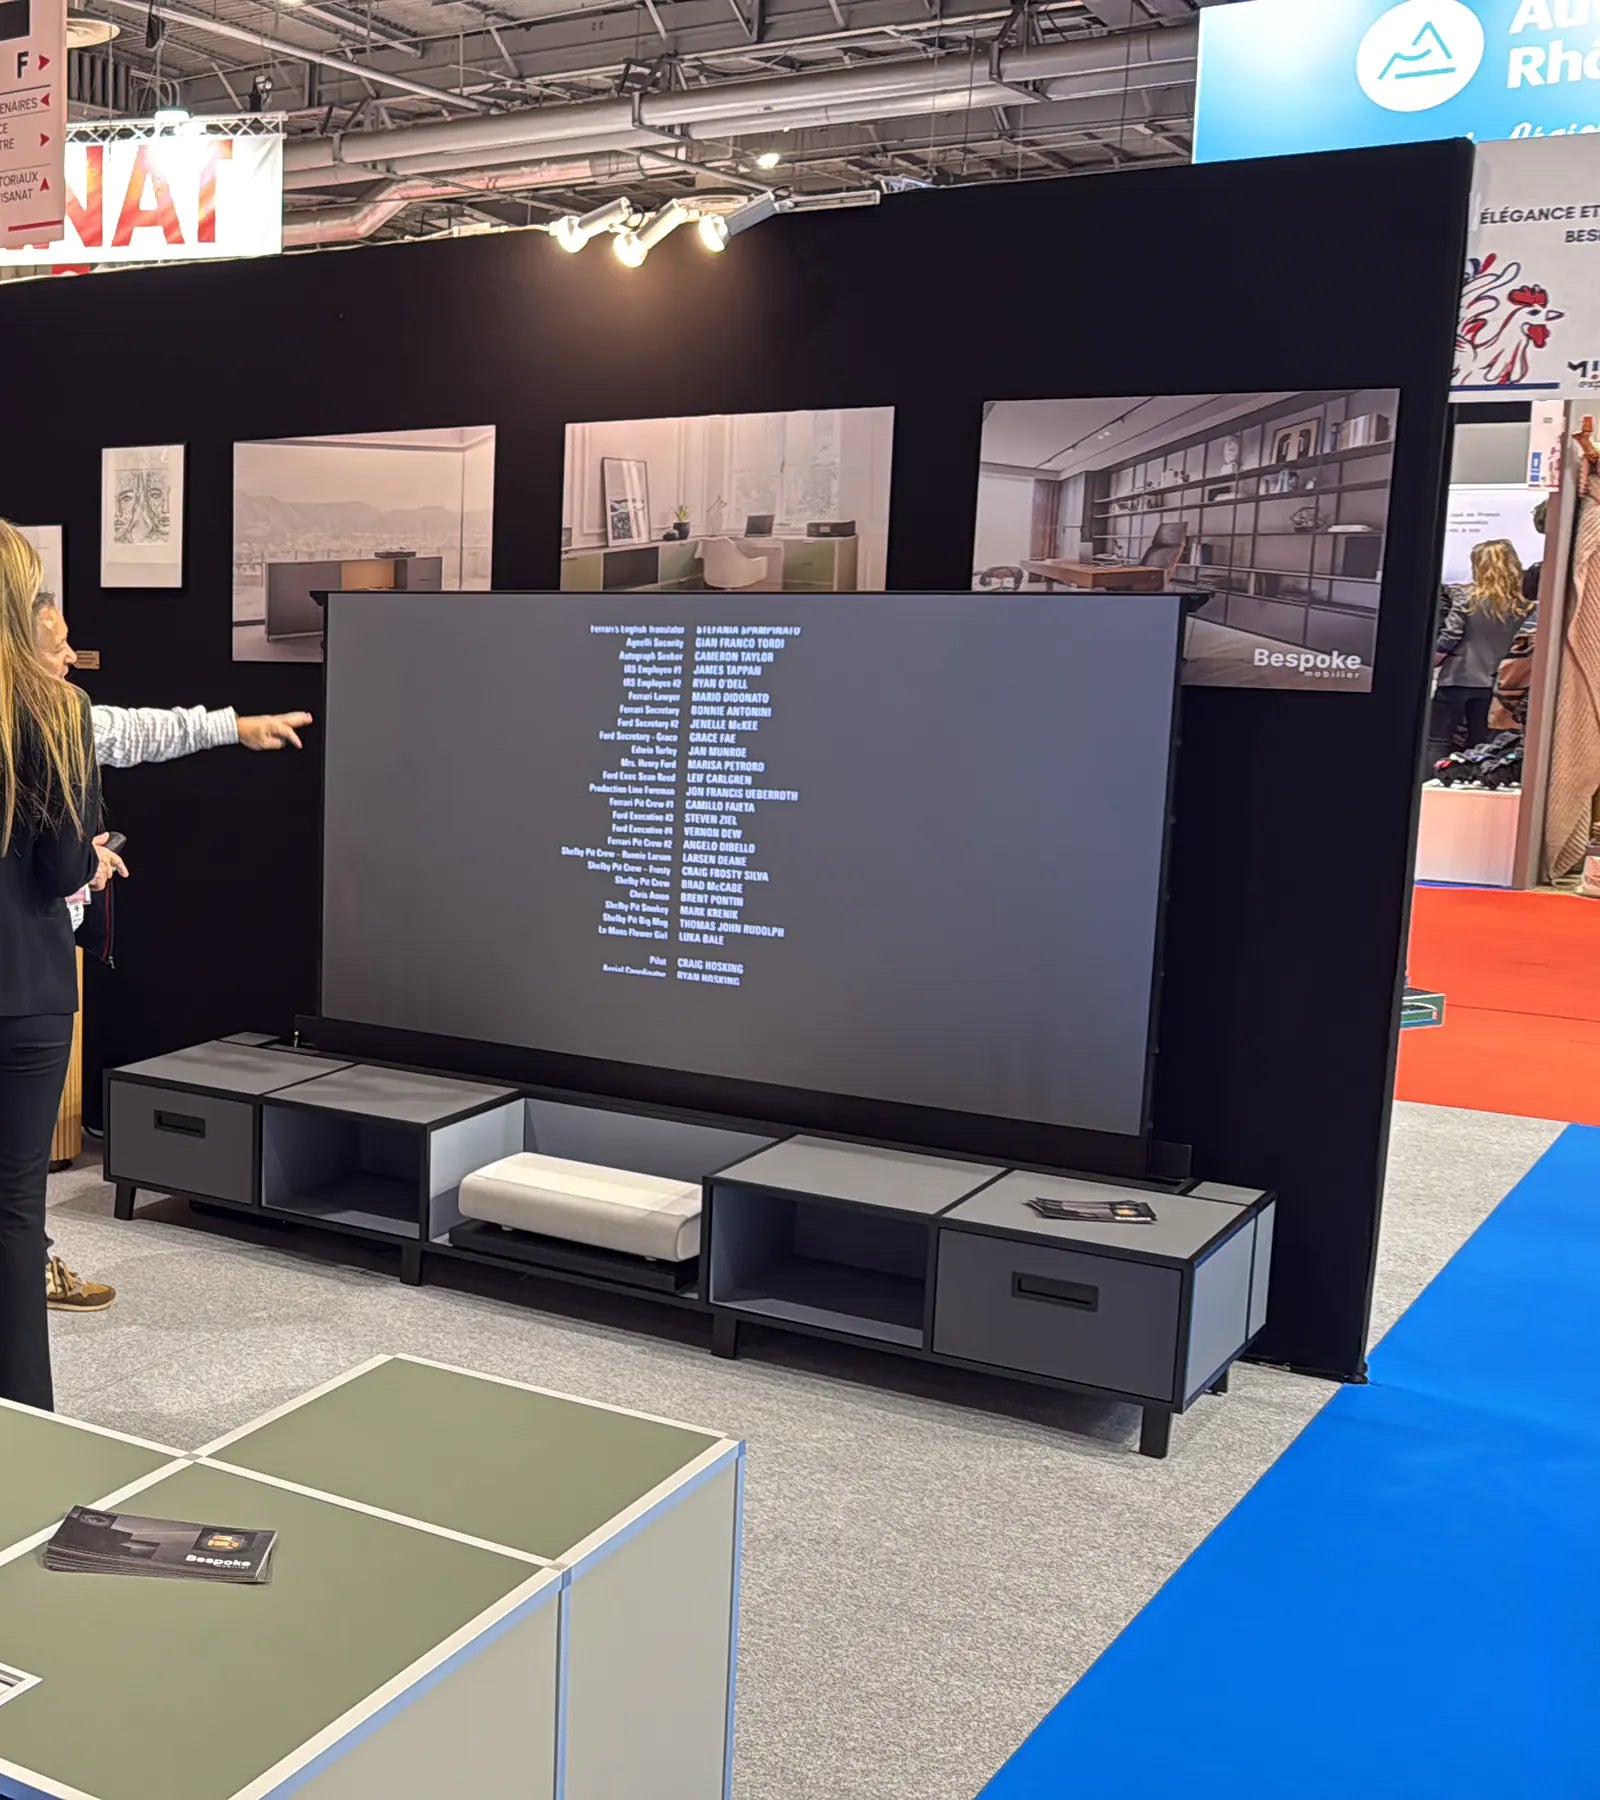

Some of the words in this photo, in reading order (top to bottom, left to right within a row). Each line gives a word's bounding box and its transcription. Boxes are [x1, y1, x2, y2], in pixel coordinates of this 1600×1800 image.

[1508, 0, 1600, 34] Au
[17, 51, 29, 78] F
[1480, 206, 1576, 224] ÉLÉGANCE
[1565, 229, 1600, 242] BES
[696, 638, 717, 648] GIAN
[720, 638, 755, 648] FRANCO
[695, 652, 738, 661] CAMERON
[741, 652, 774, 662] TAYLOR
[1254, 648, 1361, 672] Bespoke
[693, 665, 724, 675] JAMES
[726, 665, 762, 675] TAPPAN
[693, 679, 716, 688] RYAN
[718, 679, 748, 689] O'DELL
[692, 692, 721, 702] MARIO
[723, 693, 769, 703] DIDONATO
[645, 706, 680, 716] Secretary
[690, 706, 725, 716] BONNIE
[727, 707, 772, 717] ANTONINI
[618, 718, 633, 727] Ford
[635, 718, 668, 729] Secretary
[690, 719, 726, 729] JENELLE
[728, 720, 758, 730] McKEE
[599, 731, 615, 740] Ford
[617, 732, 650, 742] Secretary
[690, 733, 718, 743] GRACE
[720, 733, 736, 743] FAE
[688, 746, 706, 756] JAN
[709, 747, 747, 757] MUNROE
[660, 760, 676, 768] Ford
[688, 760, 722, 770] MARISA
[603, 771, 618, 780] Ford
[687, 773, 704, 783] LEIF
[706, 774, 752, 785] CARLGREN
[686, 787, 704, 796] JON
[706, 787, 743, 798] FRANCIS
[745, 789, 798, 800] UEBERROTH
[634, 798, 644, 807] Pit
[646, 799, 664, 808] Crew
[685, 800, 723, 811] CAMILLO
[725, 802, 755, 812] FAIETA
[612, 811, 628, 819] Ford
[685, 813, 717, 824] STEVEN
[719, 815, 737, 825] ZIEL
[612, 824, 628, 833] Ford
[684, 827, 719, 837] VERNON
[721, 829, 742, 839] DEW
[632, 838, 642, 847] Pit
[644, 839, 662, 848] Crew
[683, 840, 717, 851] ANGELO
[719, 842, 756, 853] DIBELLO
[682, 853, 716, 864] LARSEN
[718, 855, 747, 866] DEANE
[682, 866, 708, 877] CRAIG
[710, 868, 742, 879] FROSTY
[744, 871, 769, 881] SILVA
[681, 879, 705, 890] BRAD
[707, 881, 743, 893] McCABE
[681, 893, 709, 904] BRENT
[711, 895, 743, 907] PONTIN
[680, 906, 706, 917] MARK
[707, 908, 738, 919] KRENIK
[680, 919, 716, 930] THOMAS
[718, 922, 742, 933] JOHN
[743, 924, 785, 937] RUDOLPH
[679, 932, 701, 943] LUKA
[703, 934, 724, 945] BALE
[678, 958, 704, 969] CRAIG
[705, 961, 744, 974] HOSKING
[677, 971, 700, 982] RYAN
[186, 1554, 251, 1567] Bespoke
